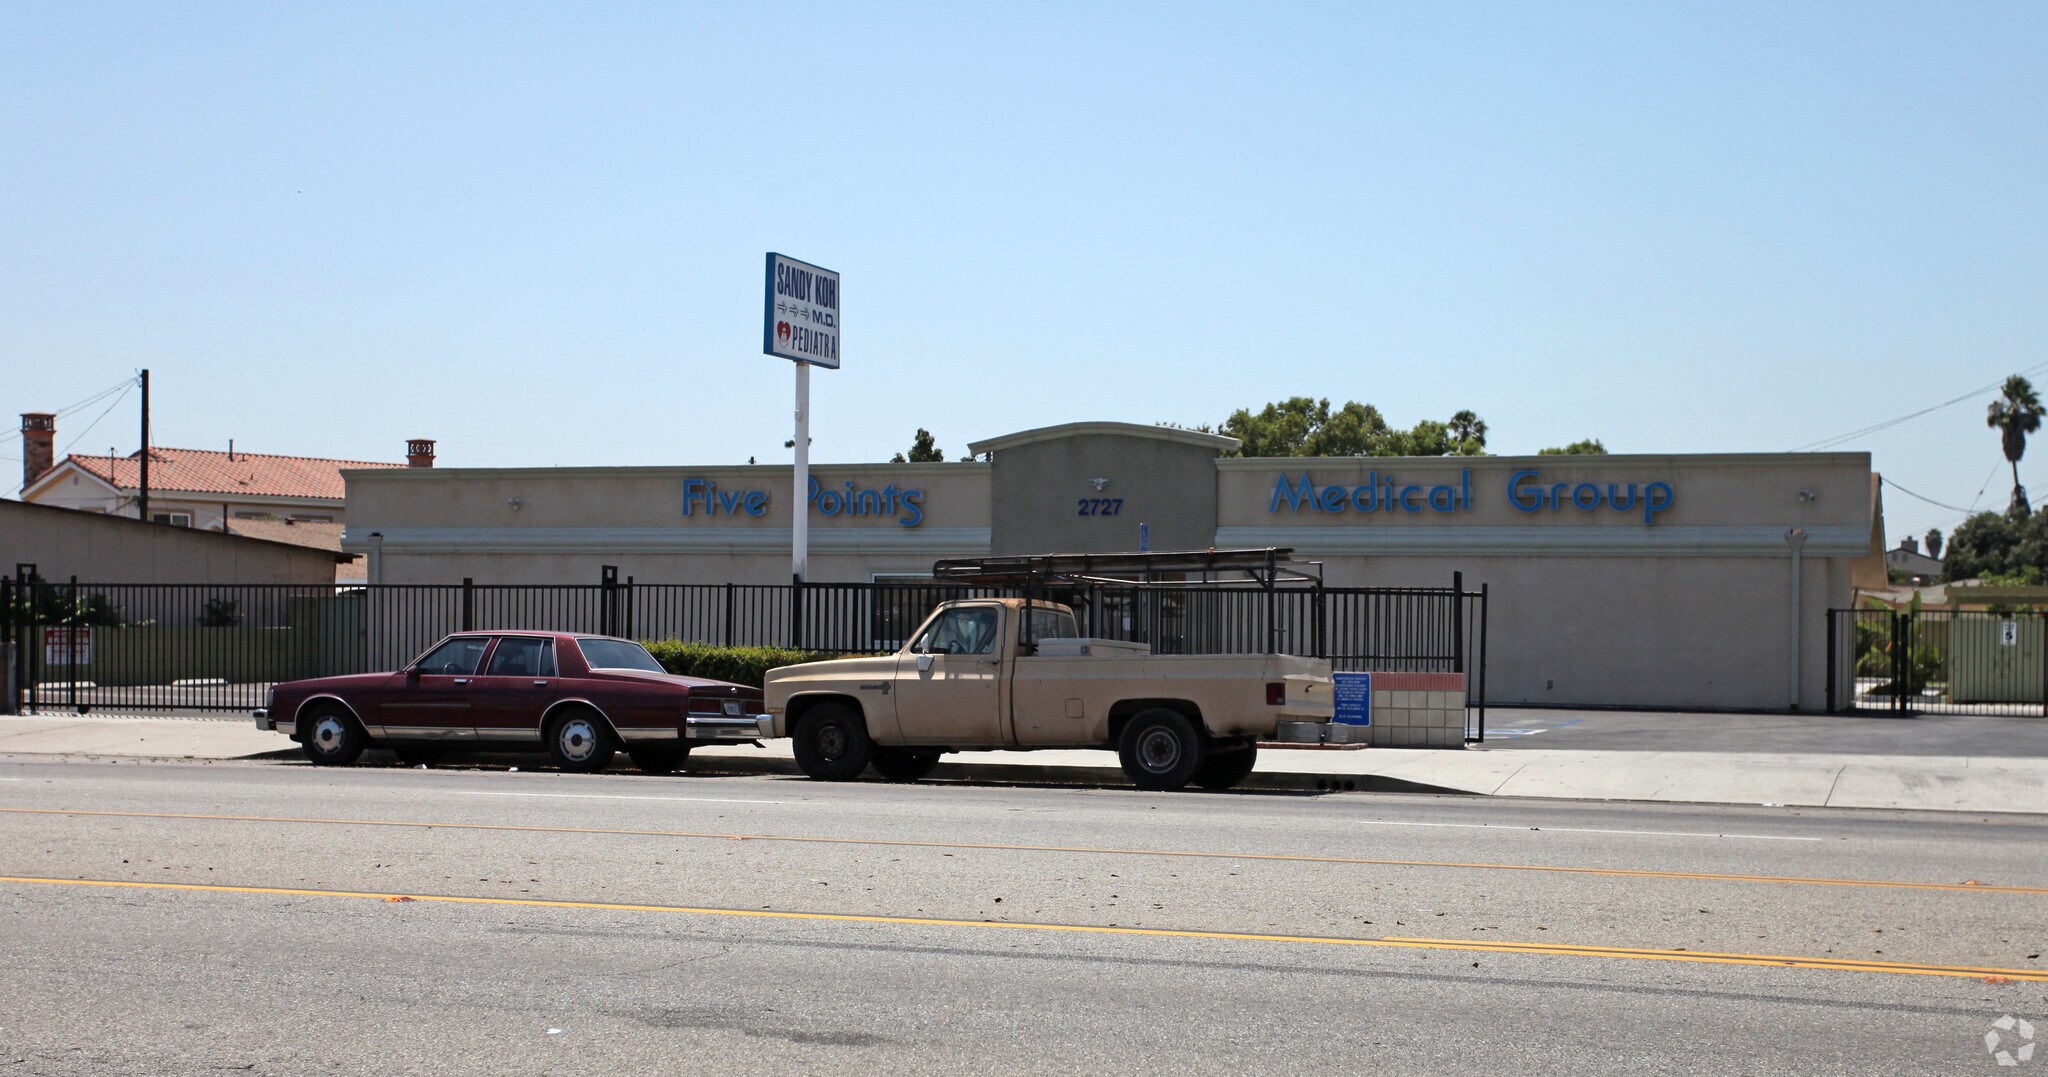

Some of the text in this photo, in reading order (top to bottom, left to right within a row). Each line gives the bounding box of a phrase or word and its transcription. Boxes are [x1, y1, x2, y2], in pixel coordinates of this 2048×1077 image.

[777, 262, 836, 310] SANDY KOH
[812, 309, 836, 329] M.D.
[792, 324, 836, 360] PEDIATRA
[682, 478, 769, 517] Five
[1077, 498, 1123, 516] 2727
[1269, 467, 1674, 525] Medical Group
